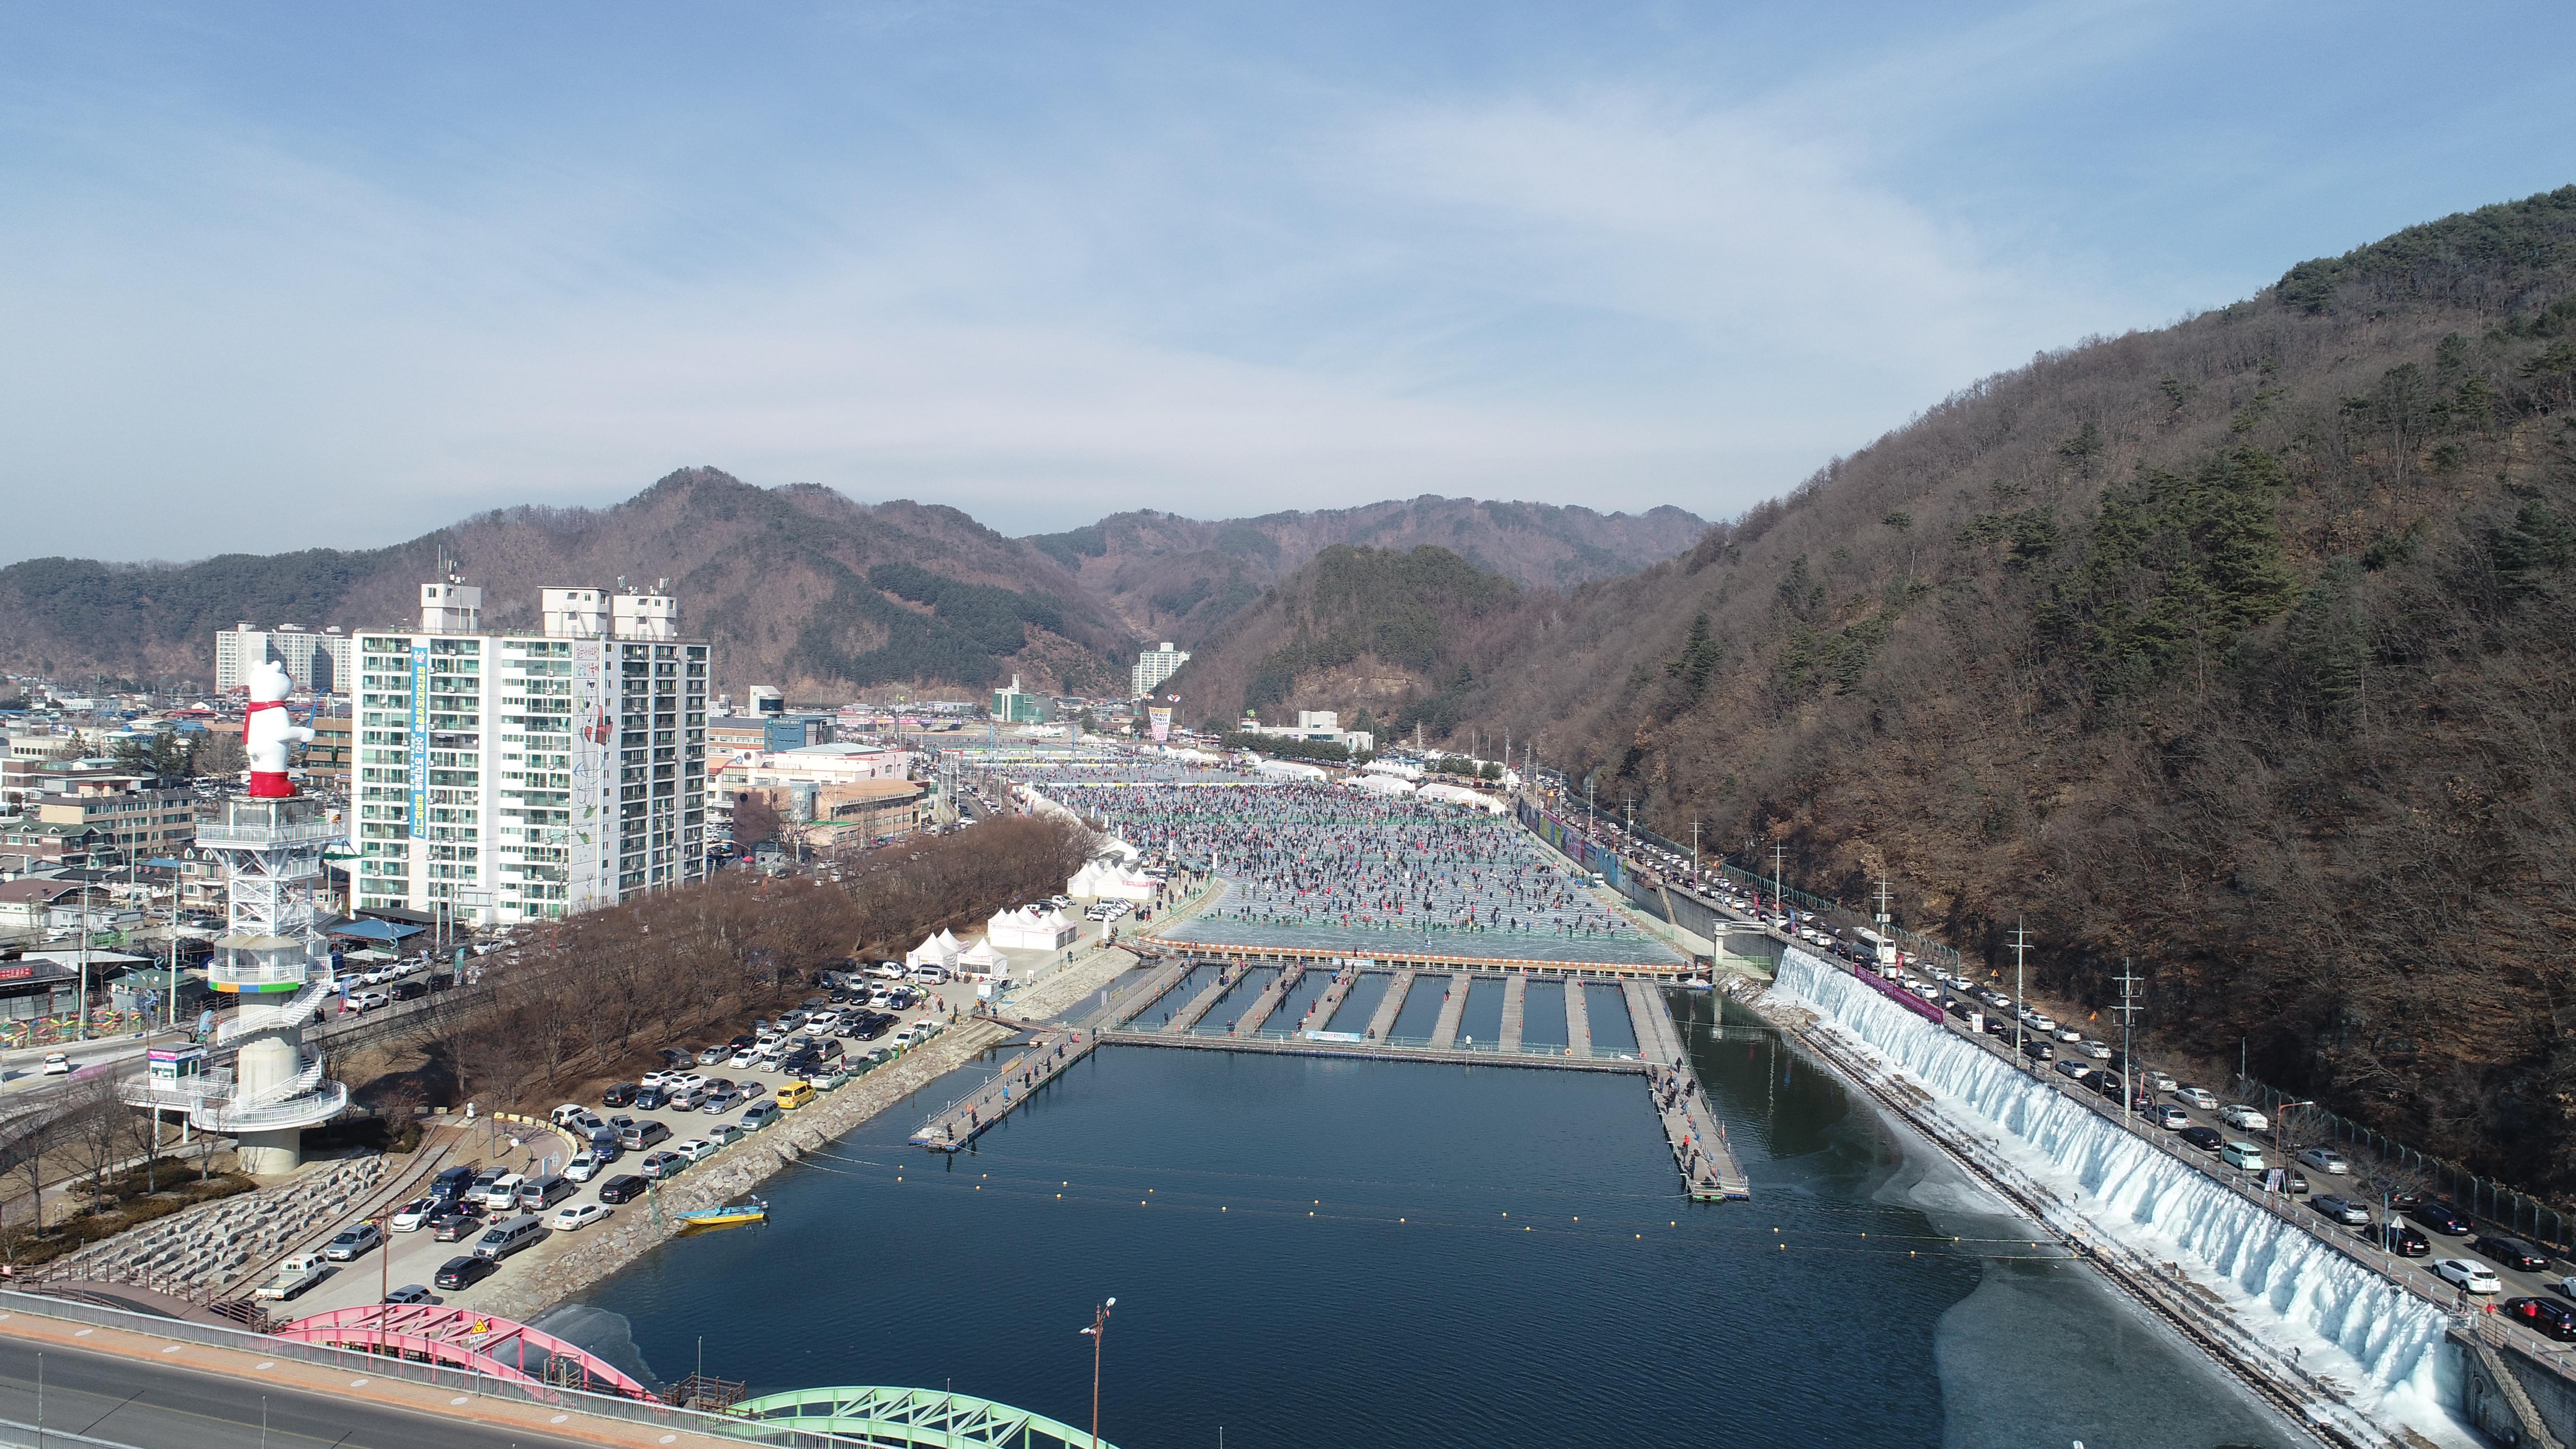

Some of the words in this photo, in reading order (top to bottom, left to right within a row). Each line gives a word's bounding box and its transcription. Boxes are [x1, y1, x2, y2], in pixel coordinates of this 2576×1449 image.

[415, 666, 426, 733] 화천산천어축제에
[415, 737, 425, 754] 오신
[414, 757, 424, 791] 여러분을
[414, 794, 425, 836] 환영합니다
[1857, 966, 1867, 980] 산천어
